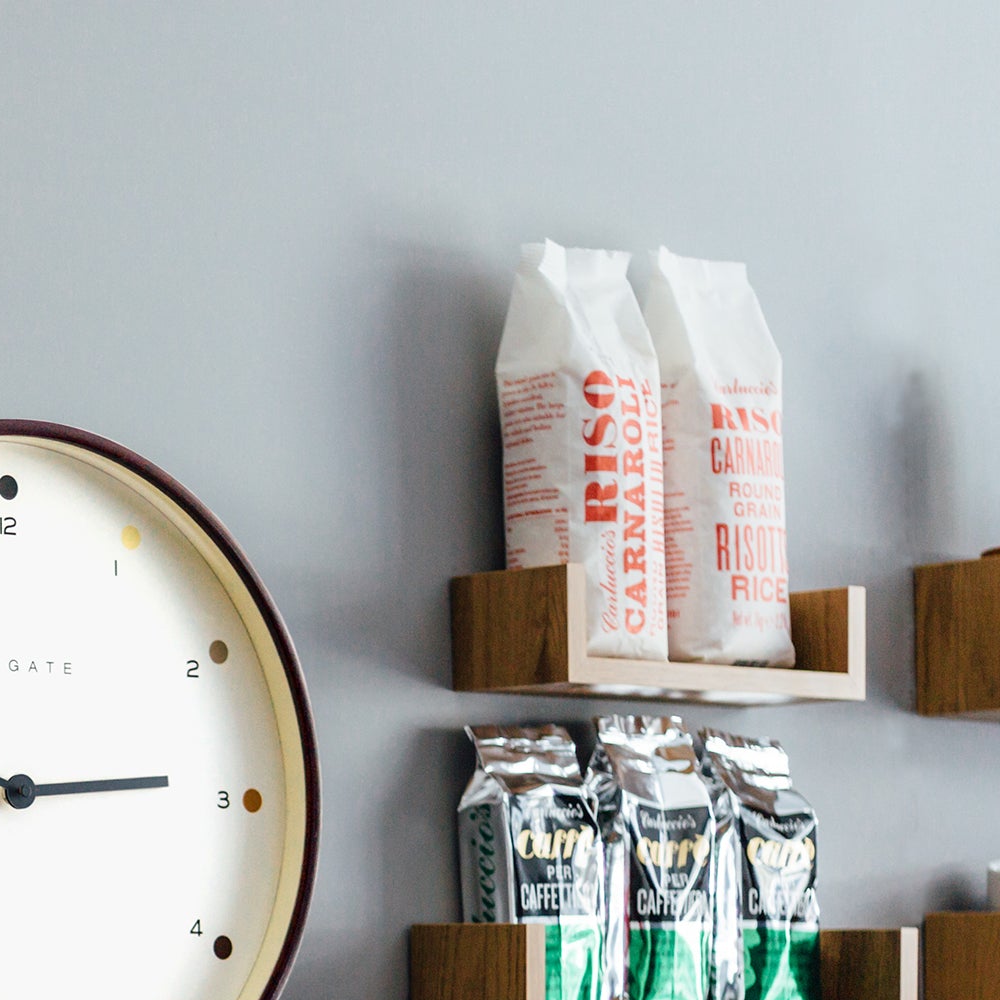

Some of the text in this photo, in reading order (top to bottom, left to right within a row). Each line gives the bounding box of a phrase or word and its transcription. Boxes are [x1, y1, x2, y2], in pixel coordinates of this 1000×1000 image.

[582, 370, 618, 523] RISO
[616, 375, 647, 635] CARNAROLI
[0, 517, 16, 535] 12
[601, 528, 619, 634] Carluccio's
[731, 575, 787, 604] RICE
[187, 660, 199, 678] 2
[218, 791, 230, 809] 3
[547, 865, 572, 880] PER
[190, 919, 203, 936] 4
